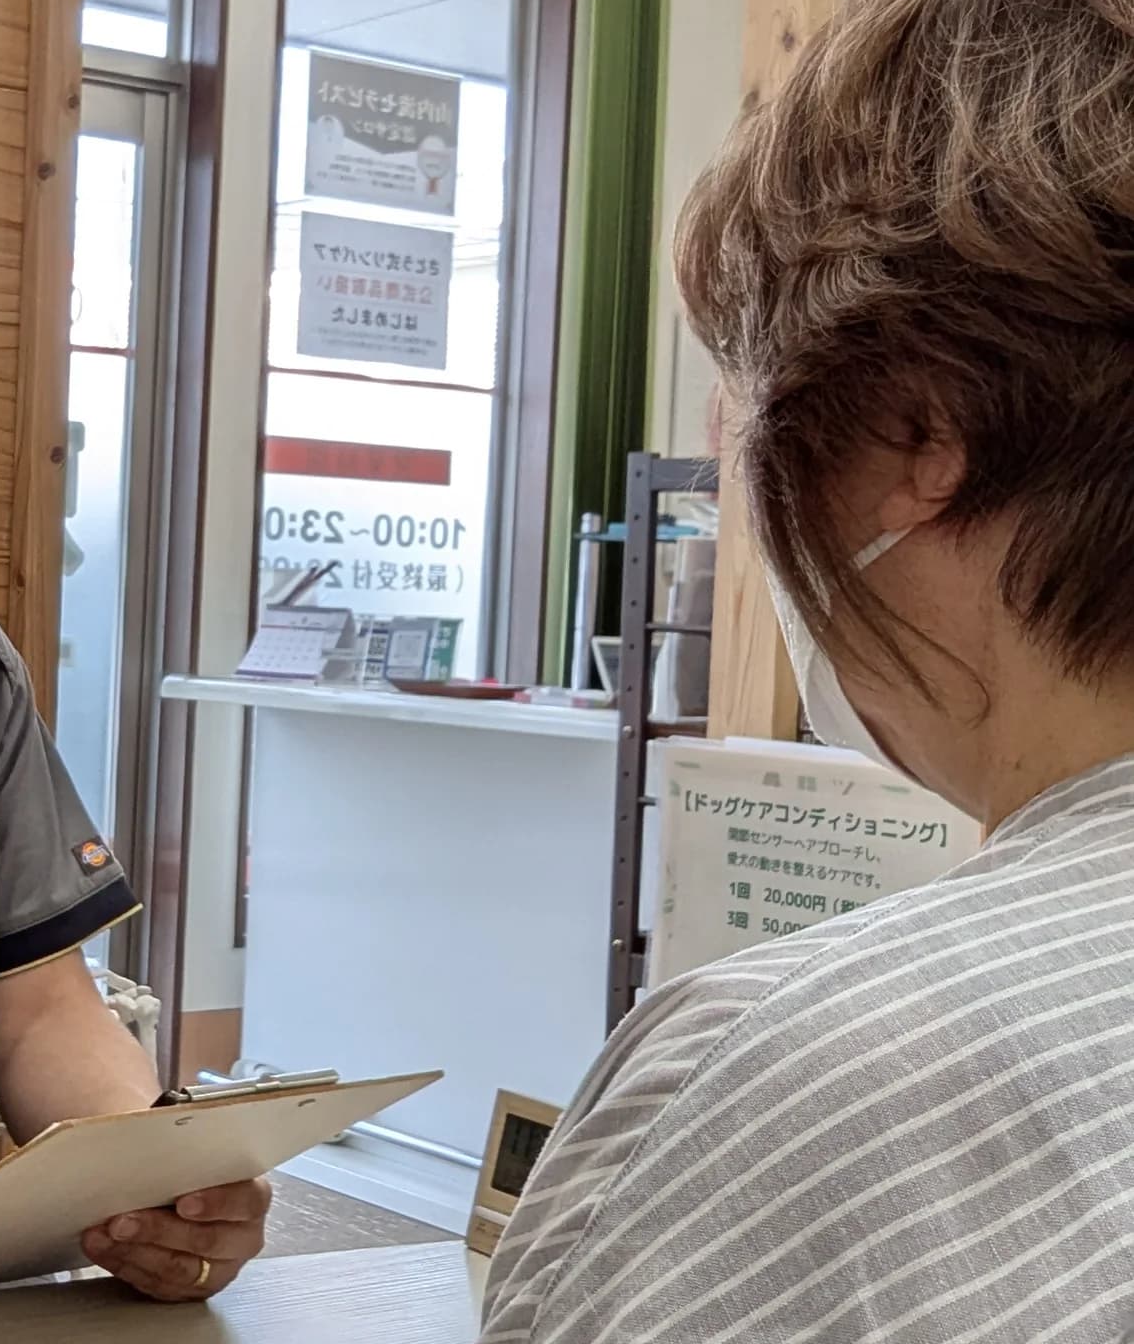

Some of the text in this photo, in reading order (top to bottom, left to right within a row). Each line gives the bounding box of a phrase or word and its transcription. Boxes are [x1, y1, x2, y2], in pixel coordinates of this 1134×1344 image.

[685, 790, 948, 848] 【ドッグケアコンディショニング】
[729, 882, 751, 900] 1回
[726, 911, 749, 930] 3回
